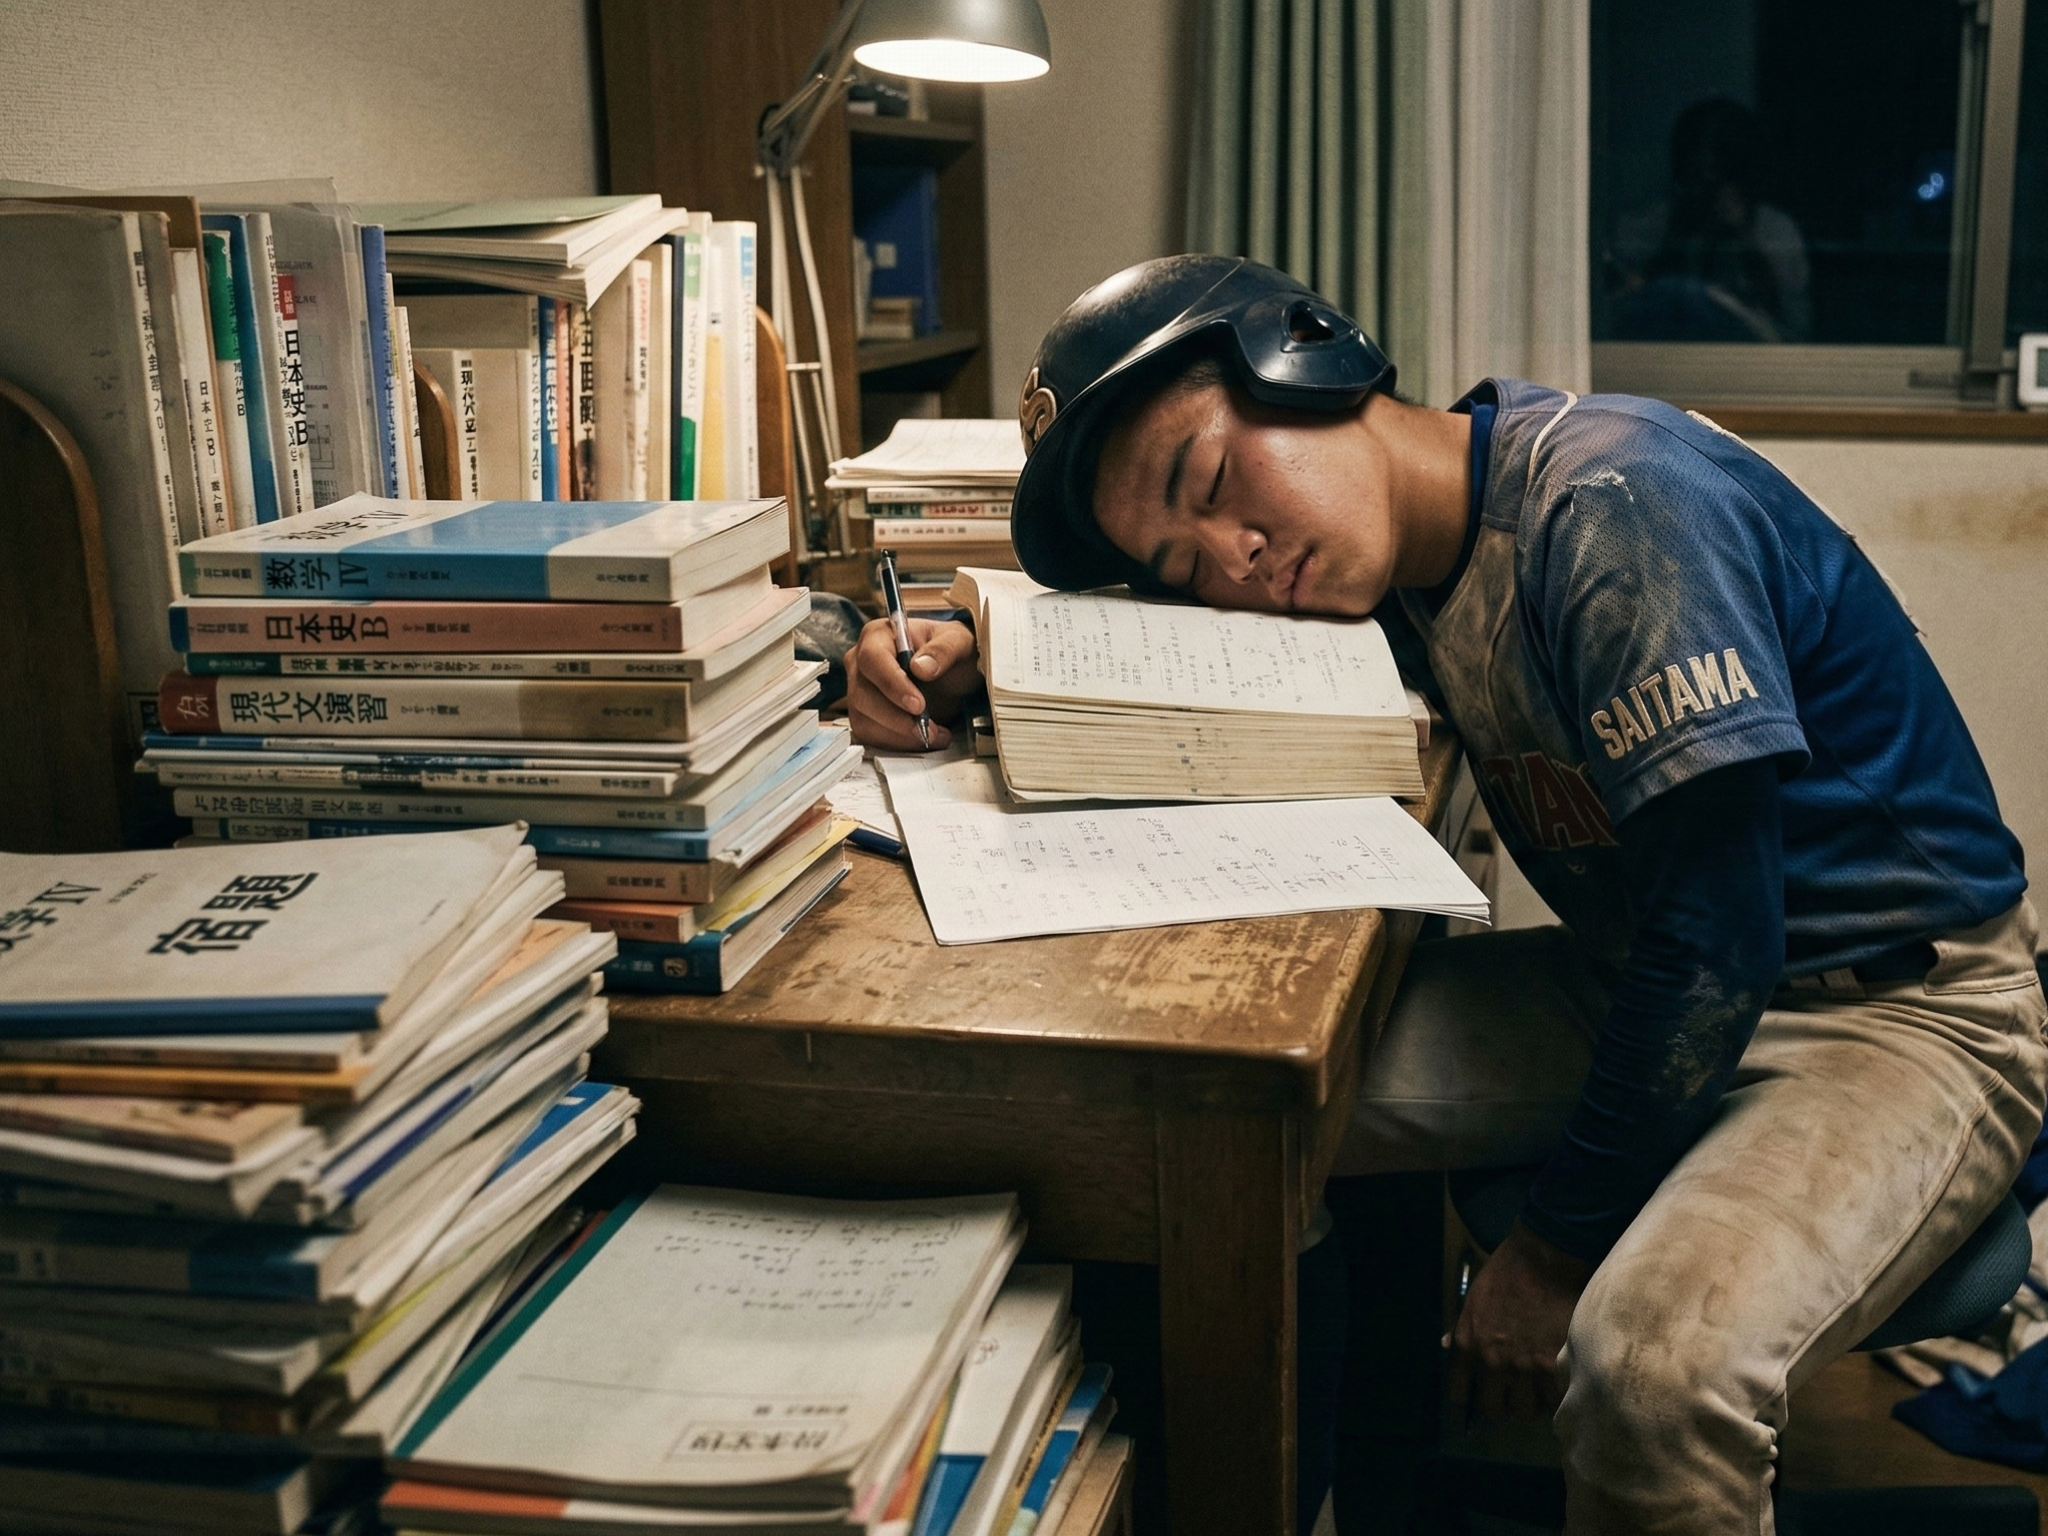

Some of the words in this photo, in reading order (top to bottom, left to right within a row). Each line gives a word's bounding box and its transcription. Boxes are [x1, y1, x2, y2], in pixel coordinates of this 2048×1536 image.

[284, 330, 309, 446] 日本史B
[265, 612, 390, 643] 日本史B
[230, 690, 389, 723] 現代文演習
[1591, 648, 1759, 760] SAITAMA
[146, 872, 319, 954] 宿題
